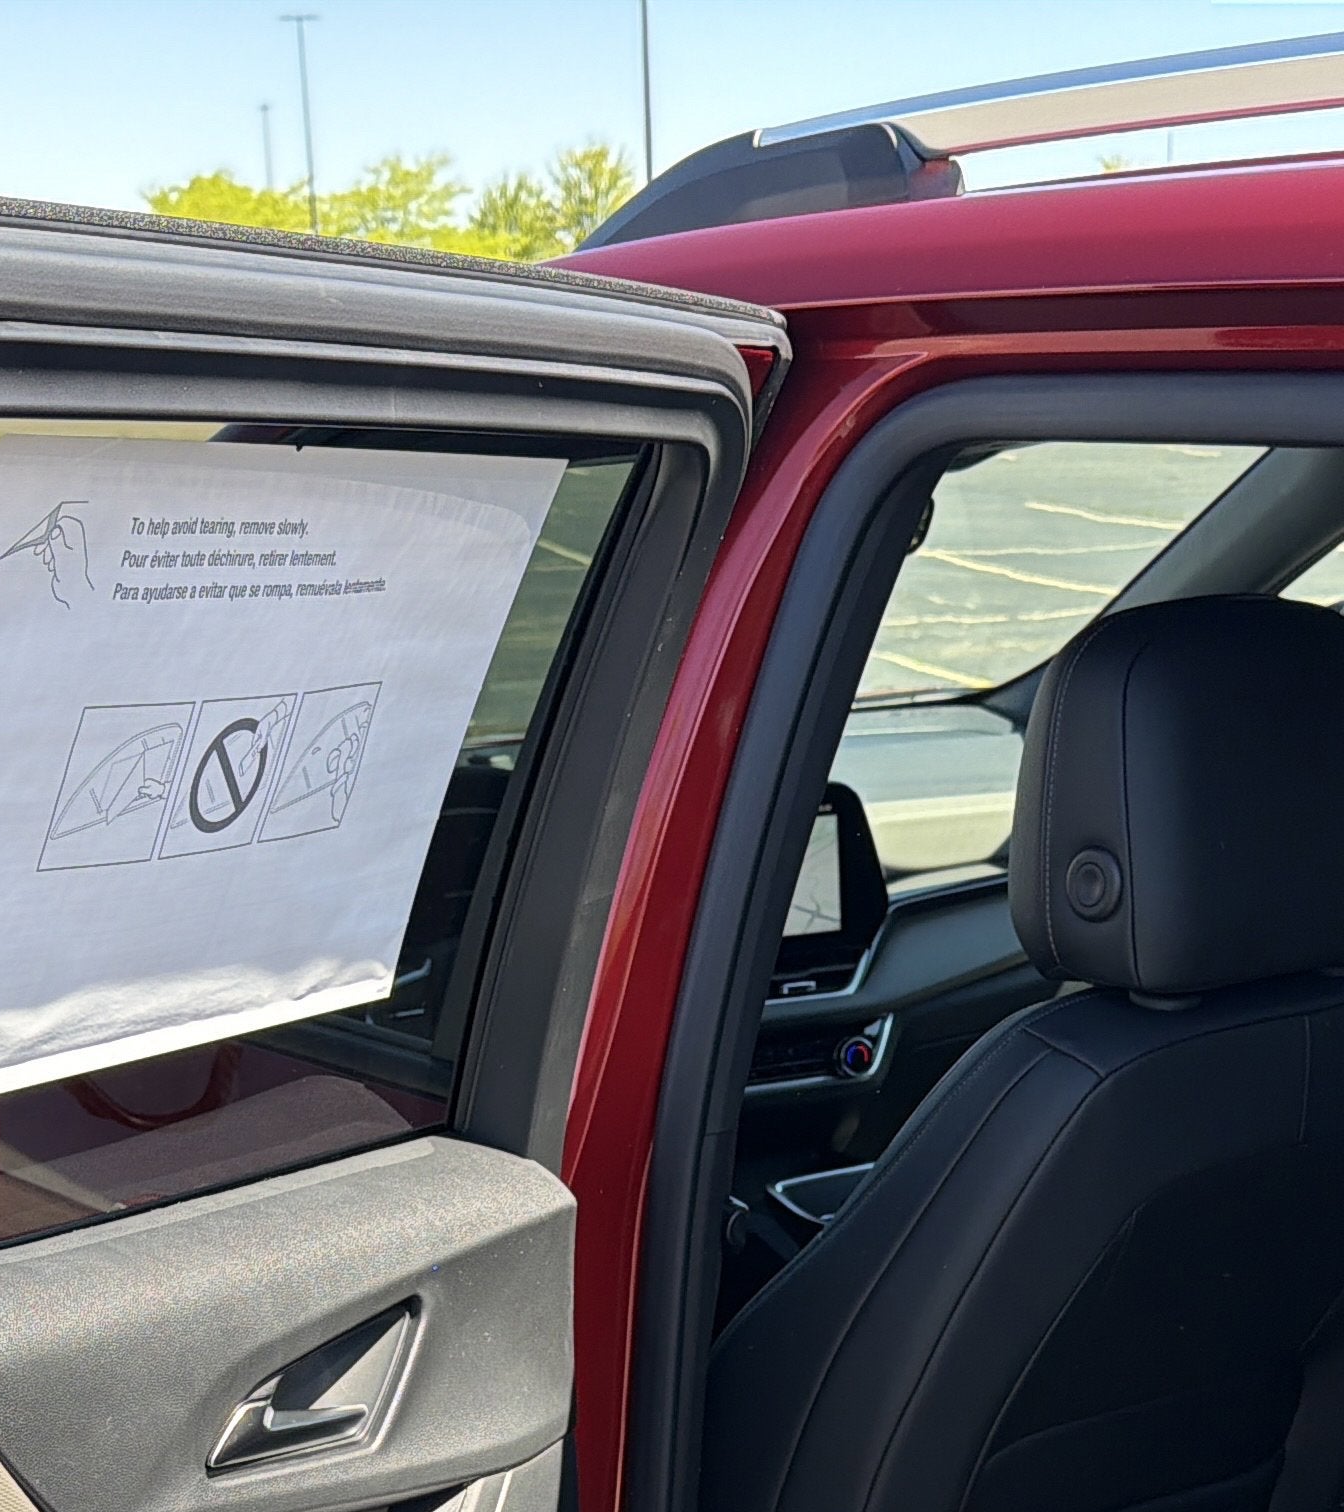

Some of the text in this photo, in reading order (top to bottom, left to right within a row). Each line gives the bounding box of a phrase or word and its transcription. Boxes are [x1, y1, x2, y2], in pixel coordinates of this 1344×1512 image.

[131, 517, 309, 539] To help avoid tearing, remove slowly.
[121, 548, 336, 569] Pour éviter toute déchirure, retirer lentement.
[113, 583, 140, 600] Para
[141, 583, 188, 604] ayudarse
[189, 585, 197, 598] a
[199, 582, 228, 599] evitar
[229, 583, 247, 602] que
[249, 584, 260, 598] se
[262, 583, 293, 600] rompa,
[296, 579, 342, 597] remuévala
